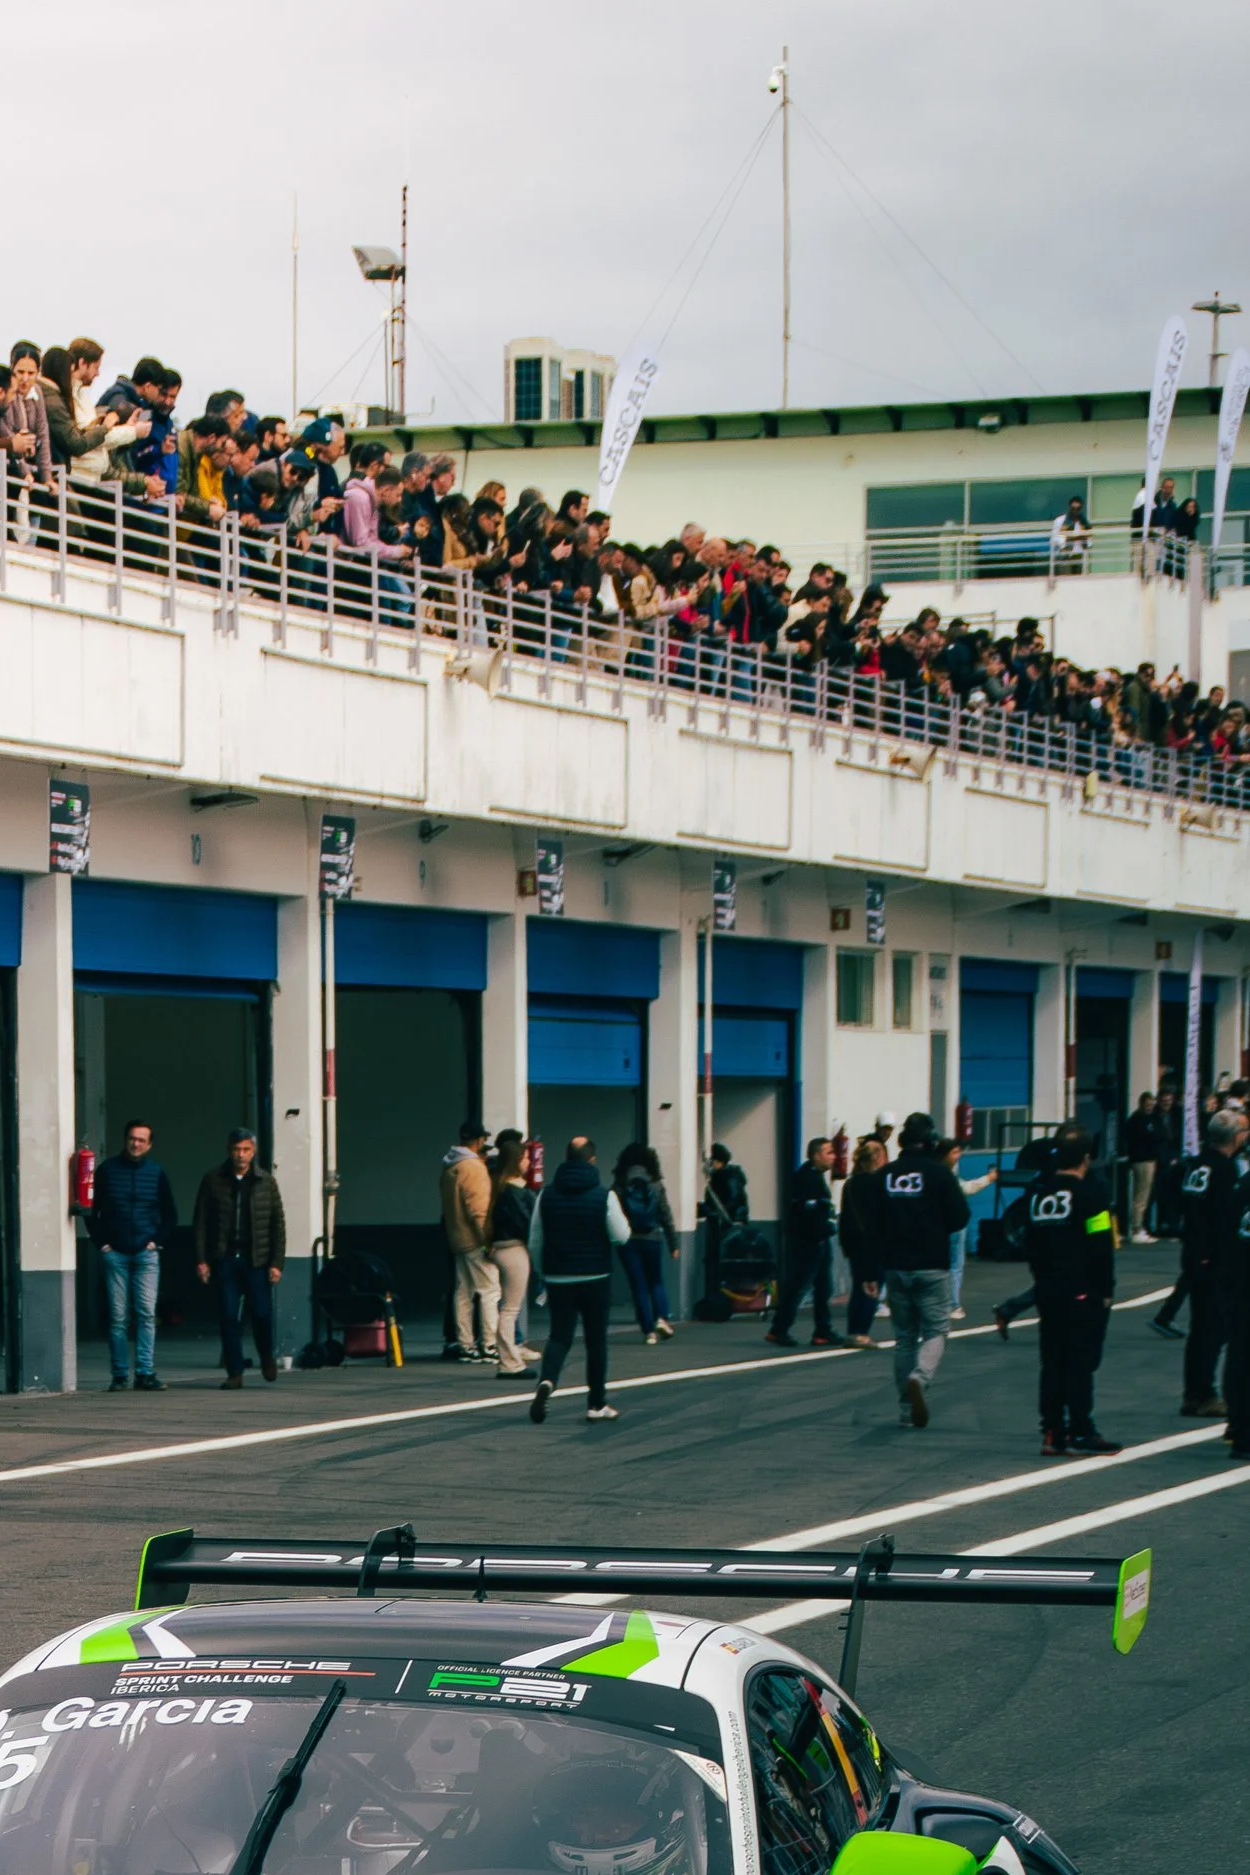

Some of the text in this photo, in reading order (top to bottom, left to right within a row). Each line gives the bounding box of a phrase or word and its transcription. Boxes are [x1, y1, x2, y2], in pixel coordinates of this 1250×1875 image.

[1150, 330, 1186, 461] CASCAIS
[599, 358, 657, 485] CASCAIS
[120, 1660, 352, 1672] PORSCHE
[437, 1665, 566, 1681] OFFICIAL LICENCE PARTNER
[110, 1683, 180, 1695] IBERICA
[114, 1674, 295, 1687] SPRINT CHALLENGE
[428, 1672, 589, 1702] P21
[428, 1691, 581, 1709] MOTORSPORT
